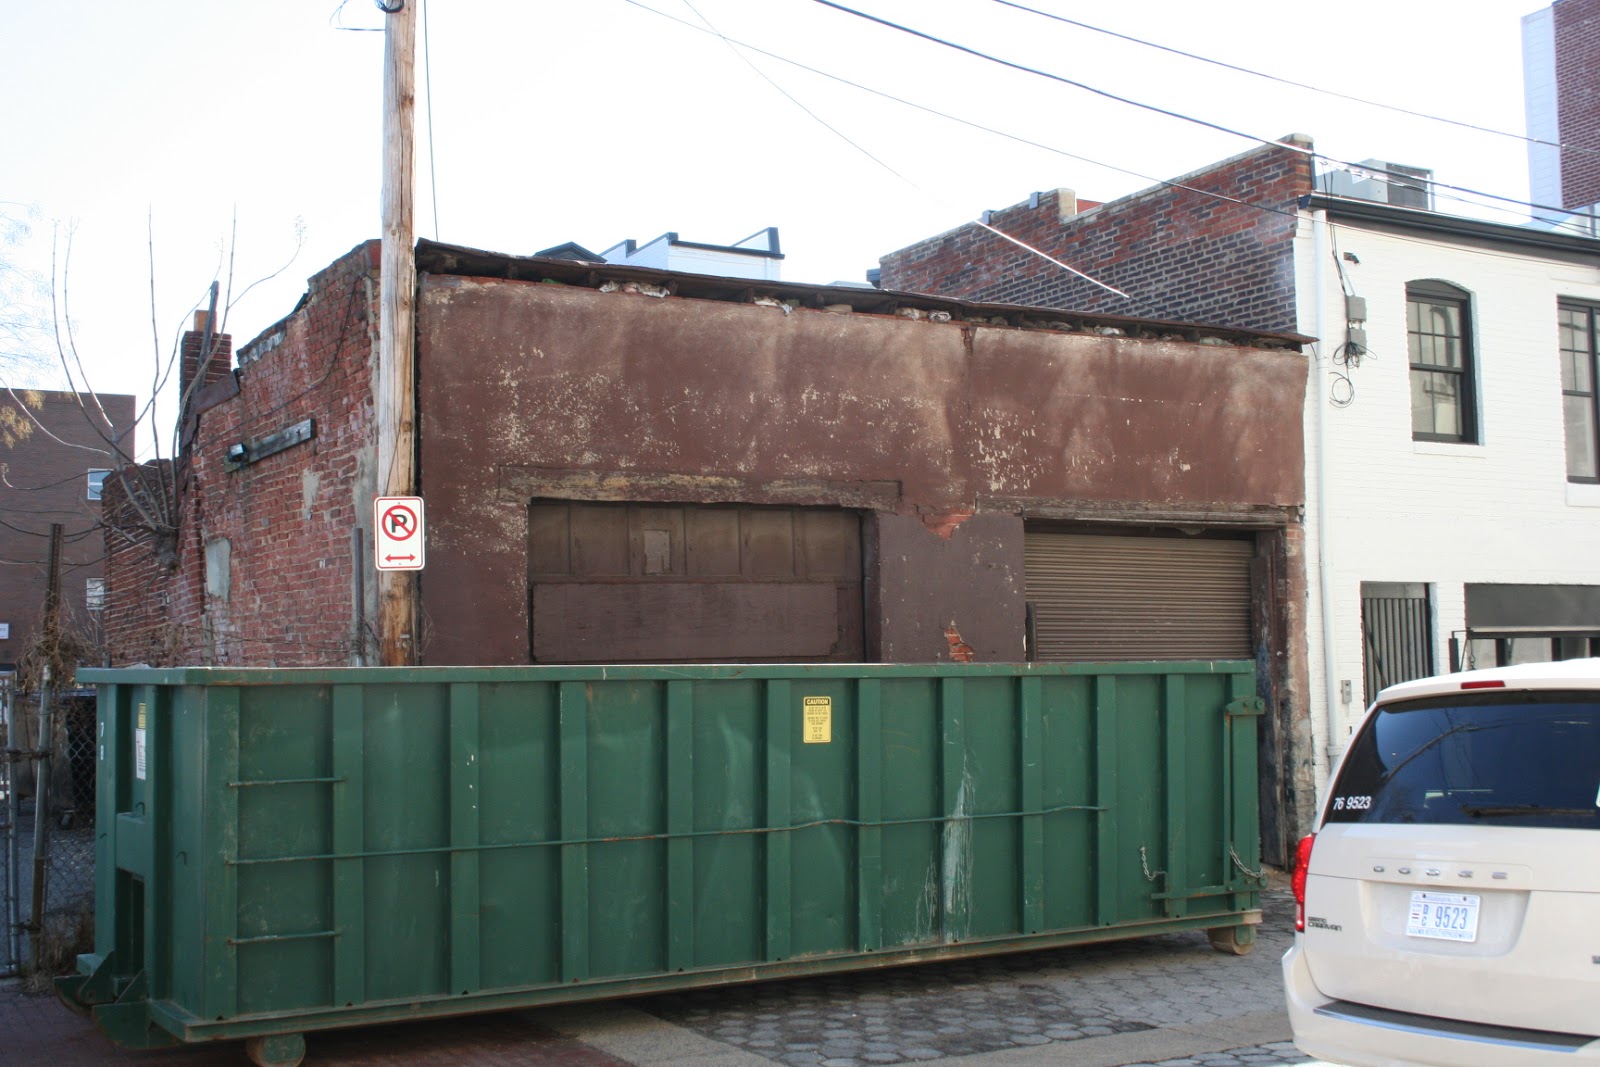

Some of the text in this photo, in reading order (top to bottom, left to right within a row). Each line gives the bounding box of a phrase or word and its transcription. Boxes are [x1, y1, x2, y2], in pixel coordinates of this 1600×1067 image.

[391, 514, 408, 533] P
[1333, 796, 1372, 811] 76 9523
[1435, 905, 1468, 930] 9523
